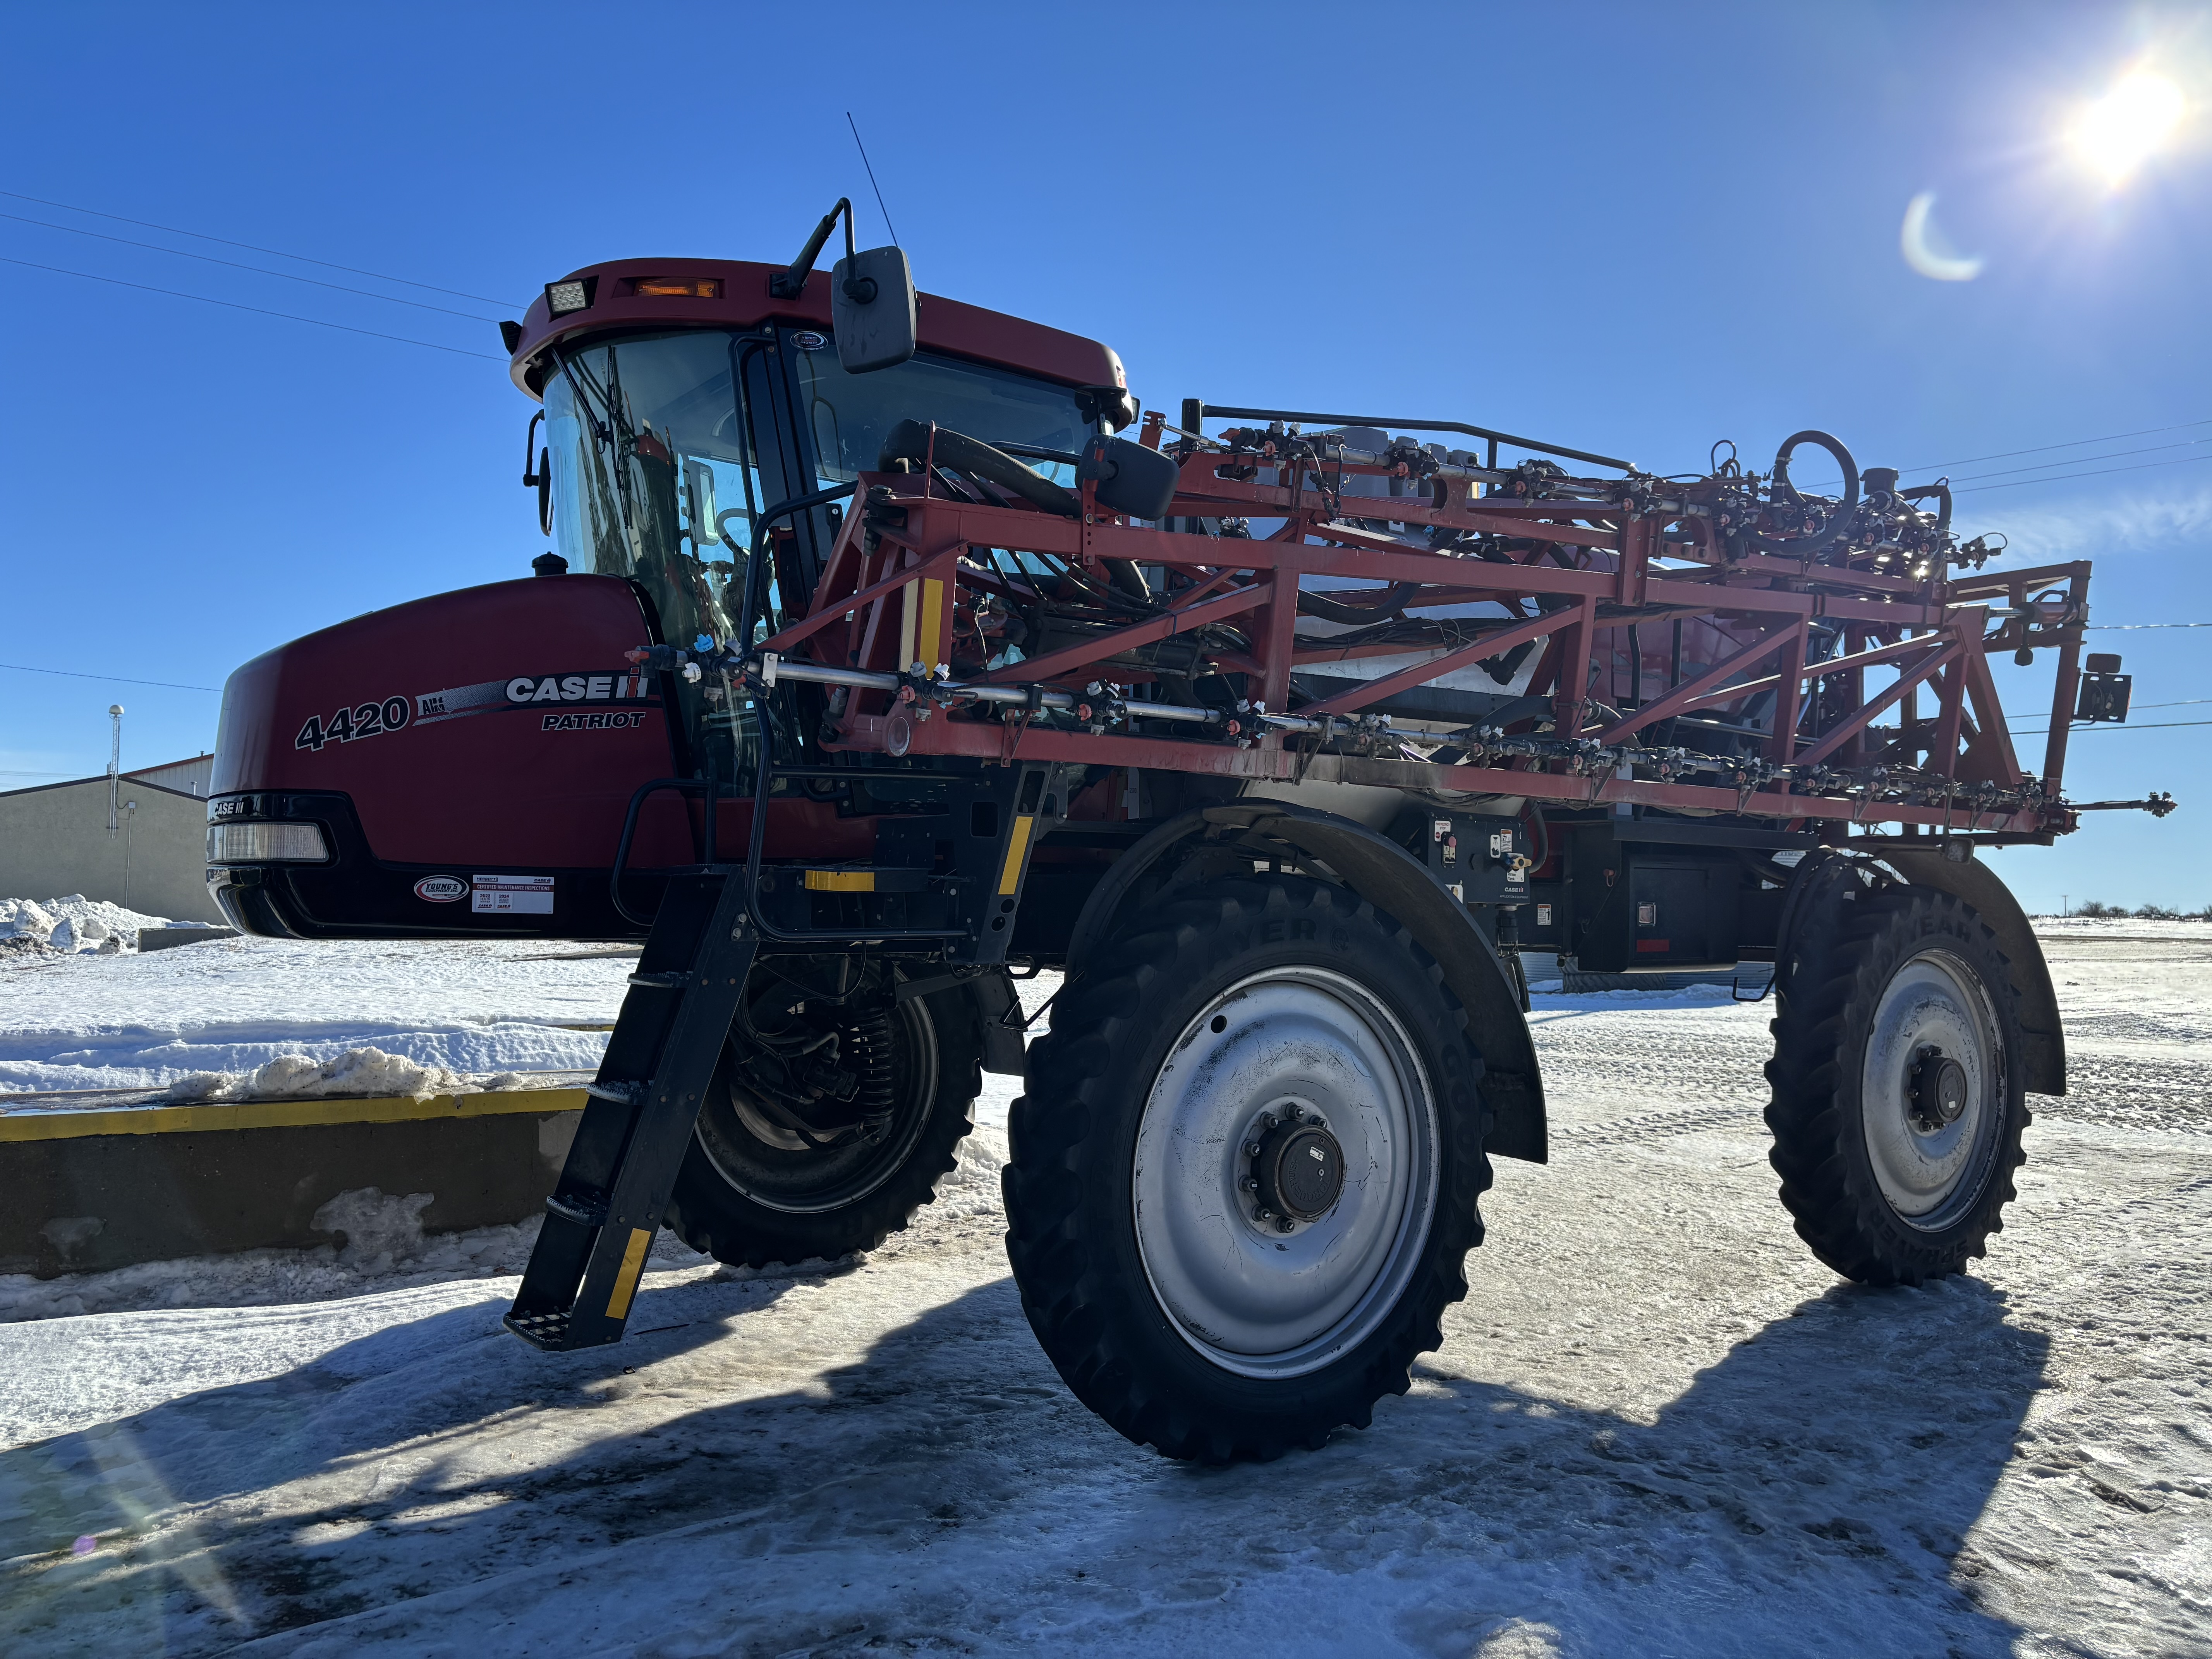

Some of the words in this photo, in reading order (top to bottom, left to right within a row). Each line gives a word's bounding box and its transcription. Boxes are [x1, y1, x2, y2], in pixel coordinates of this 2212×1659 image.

[507, 677, 612, 702] CASE
[295, 696, 410, 752] 4420
[541, 712, 646, 731] PATRIOT
[215, 802, 234, 816] CASE
[1123, 917, 1317, 1065] SPRAYER
[1360, 1043, 1474, 1386] GOODYEAR
